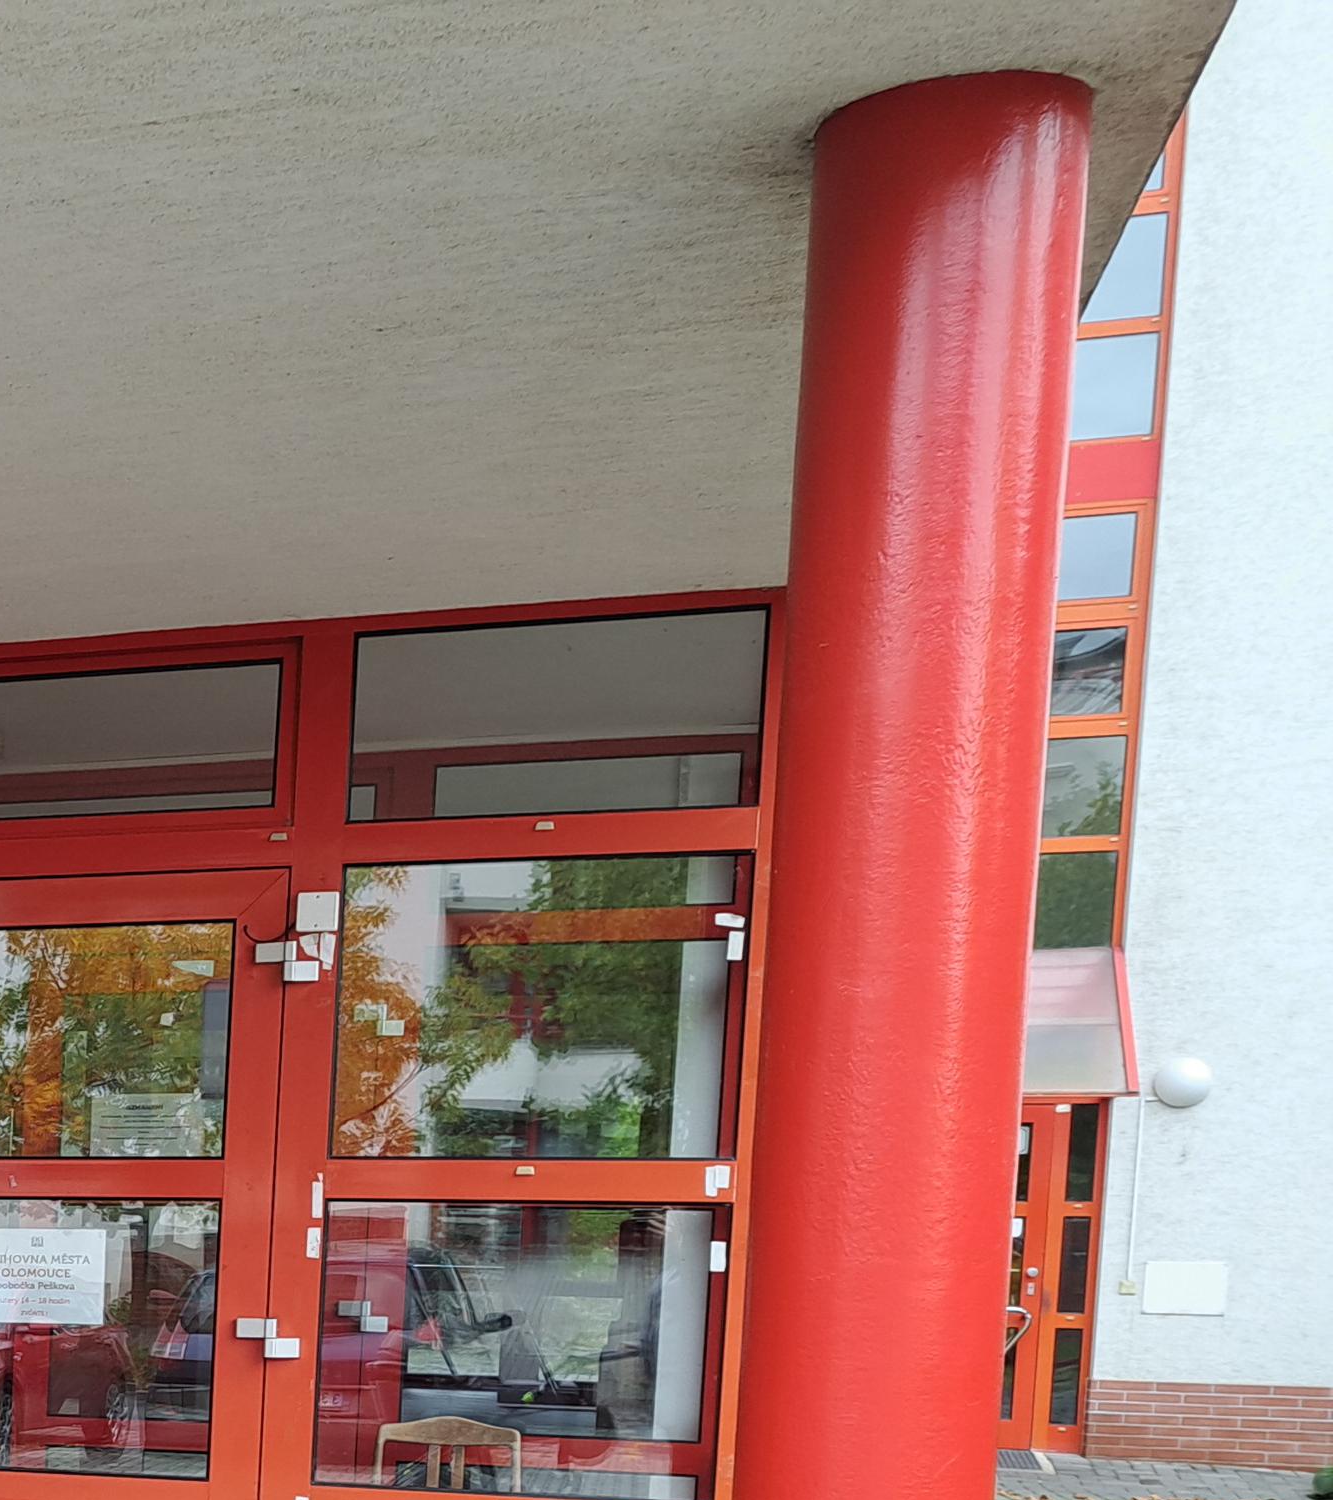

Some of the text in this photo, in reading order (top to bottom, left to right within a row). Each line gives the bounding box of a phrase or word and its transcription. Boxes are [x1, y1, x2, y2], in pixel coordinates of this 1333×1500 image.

[50, 1252, 91, 1265] MĚSTA
[0, 1267, 72, 1279] OLOMOUCE
[37, 1281, 75, 1291] Peškova
